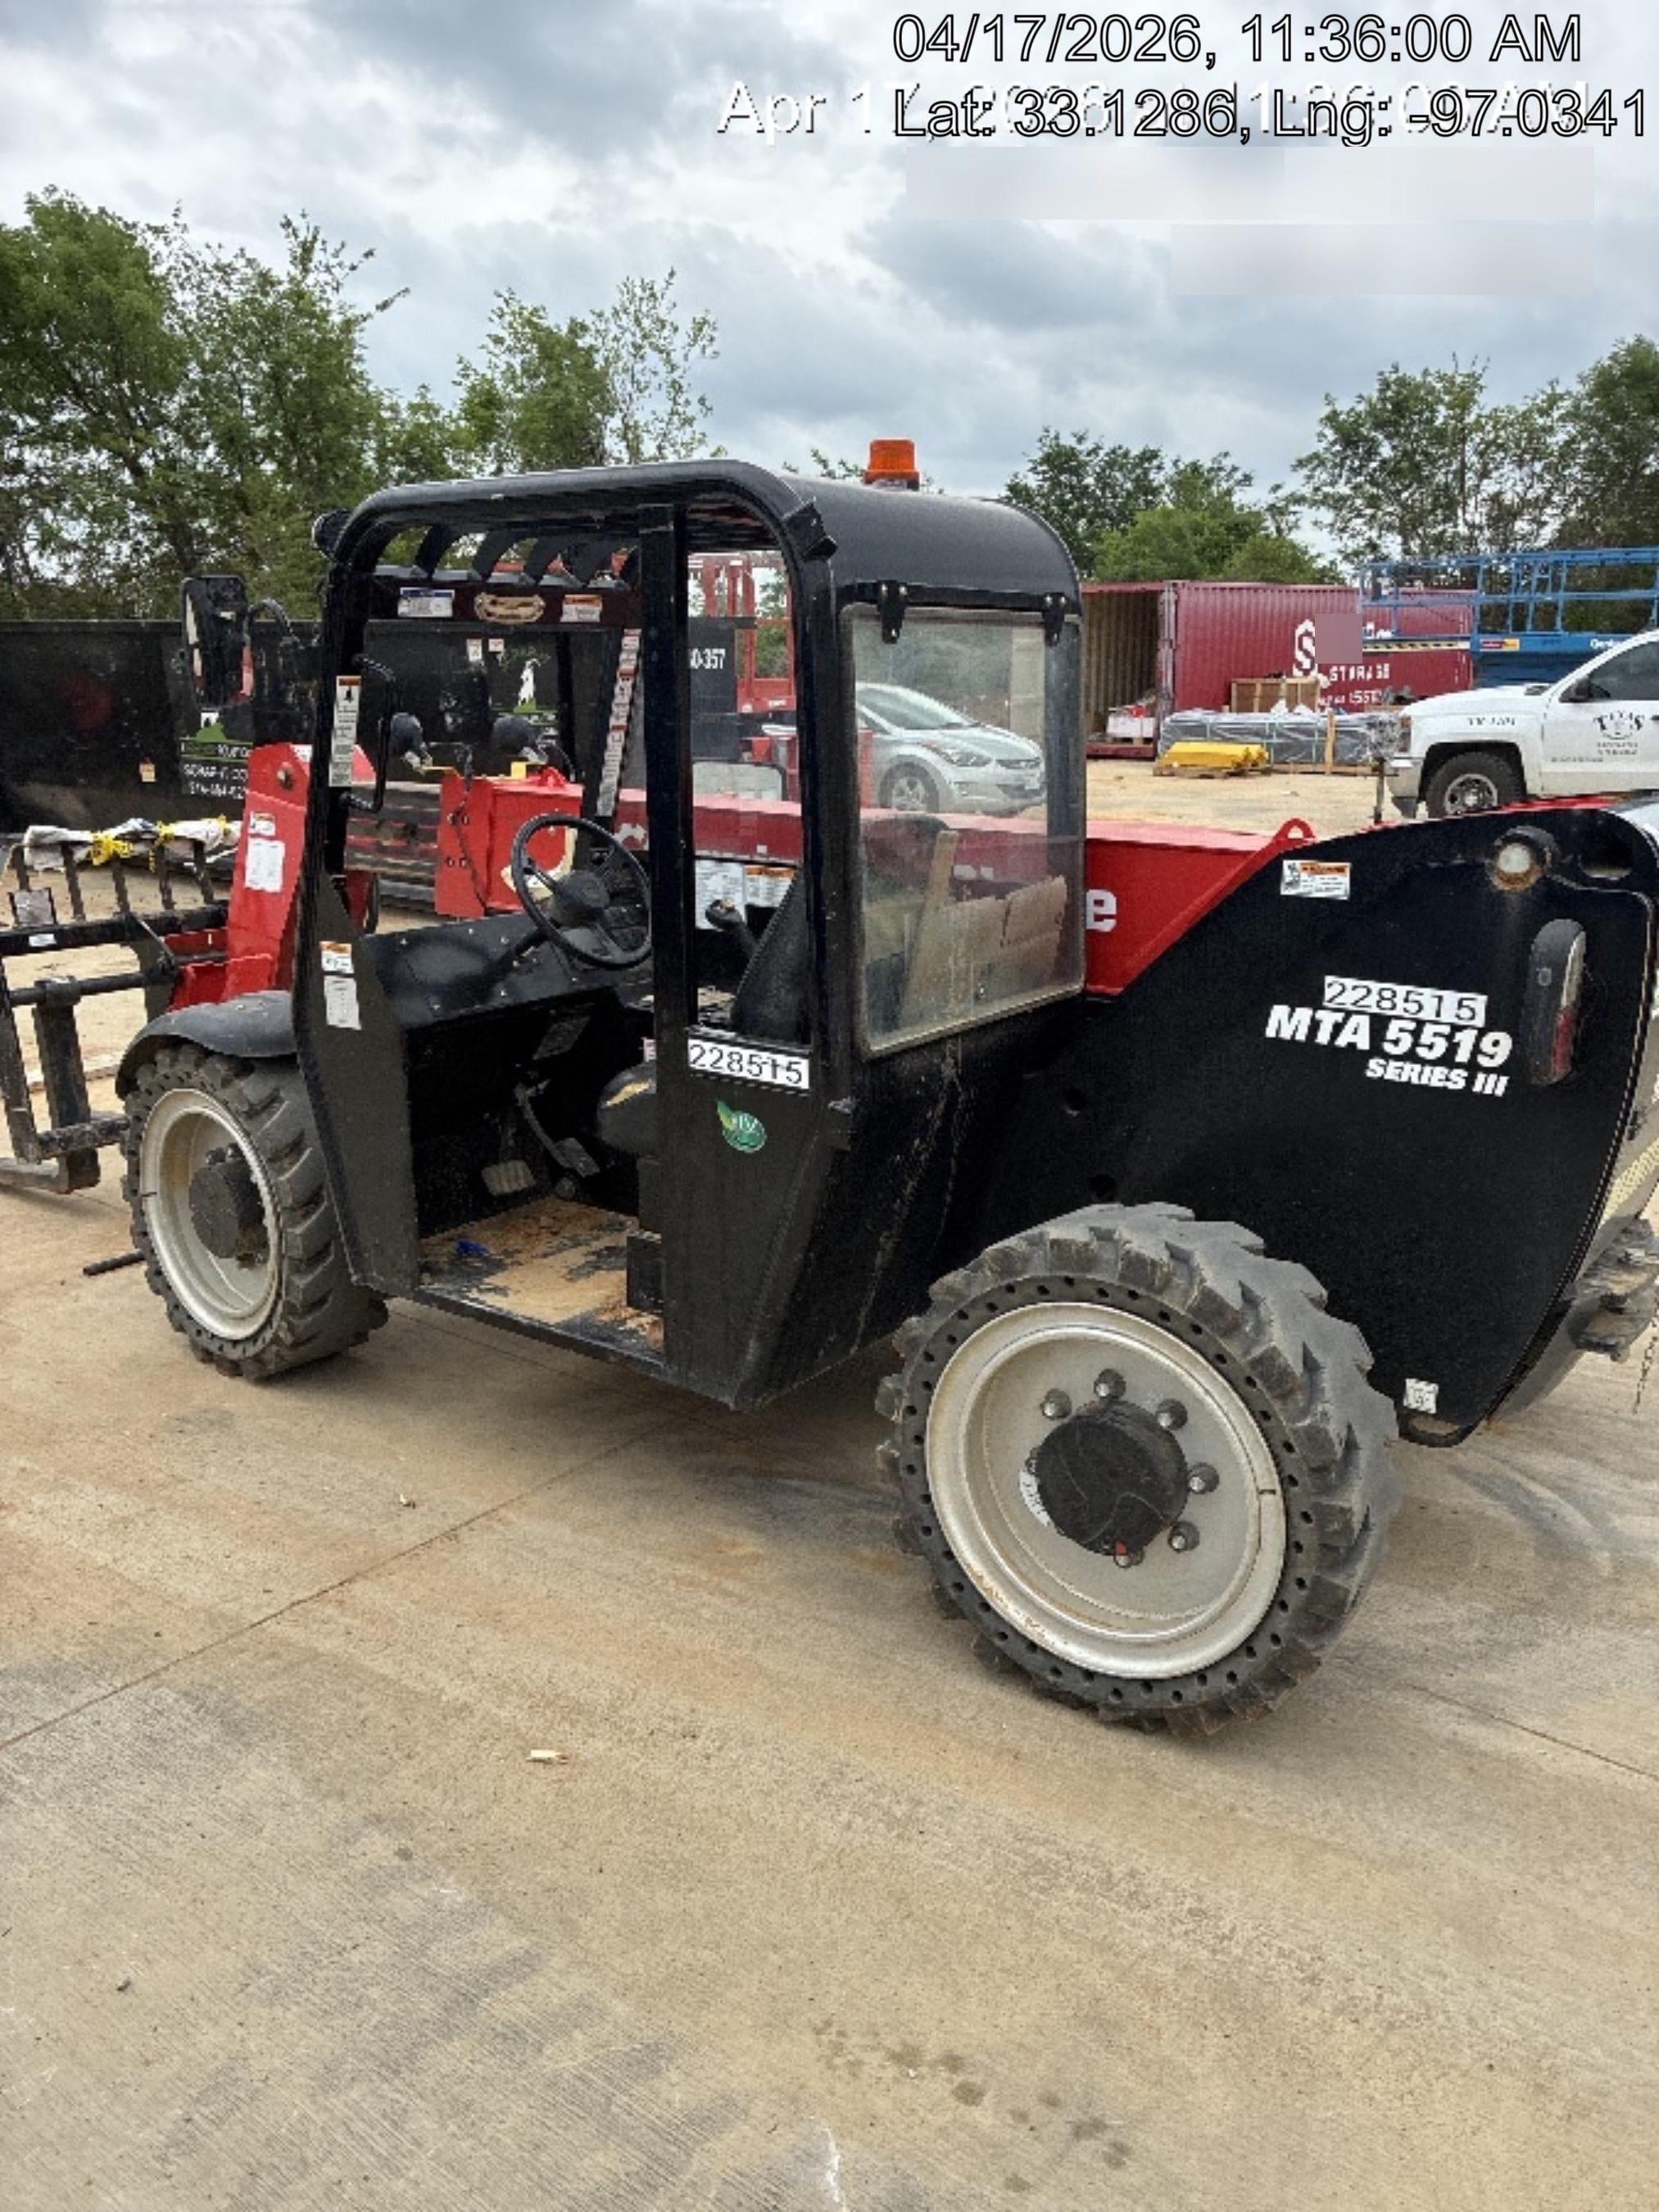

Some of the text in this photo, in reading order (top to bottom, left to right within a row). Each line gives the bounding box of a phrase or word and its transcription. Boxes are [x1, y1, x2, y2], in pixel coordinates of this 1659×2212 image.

[1326, 980, 1480, 1022] 228515
[1265, 1004, 1513, 1067] MTA 5519
[689, 1043, 803, 1085] 228515
[1364, 1058, 1510, 1097] SERIES III
